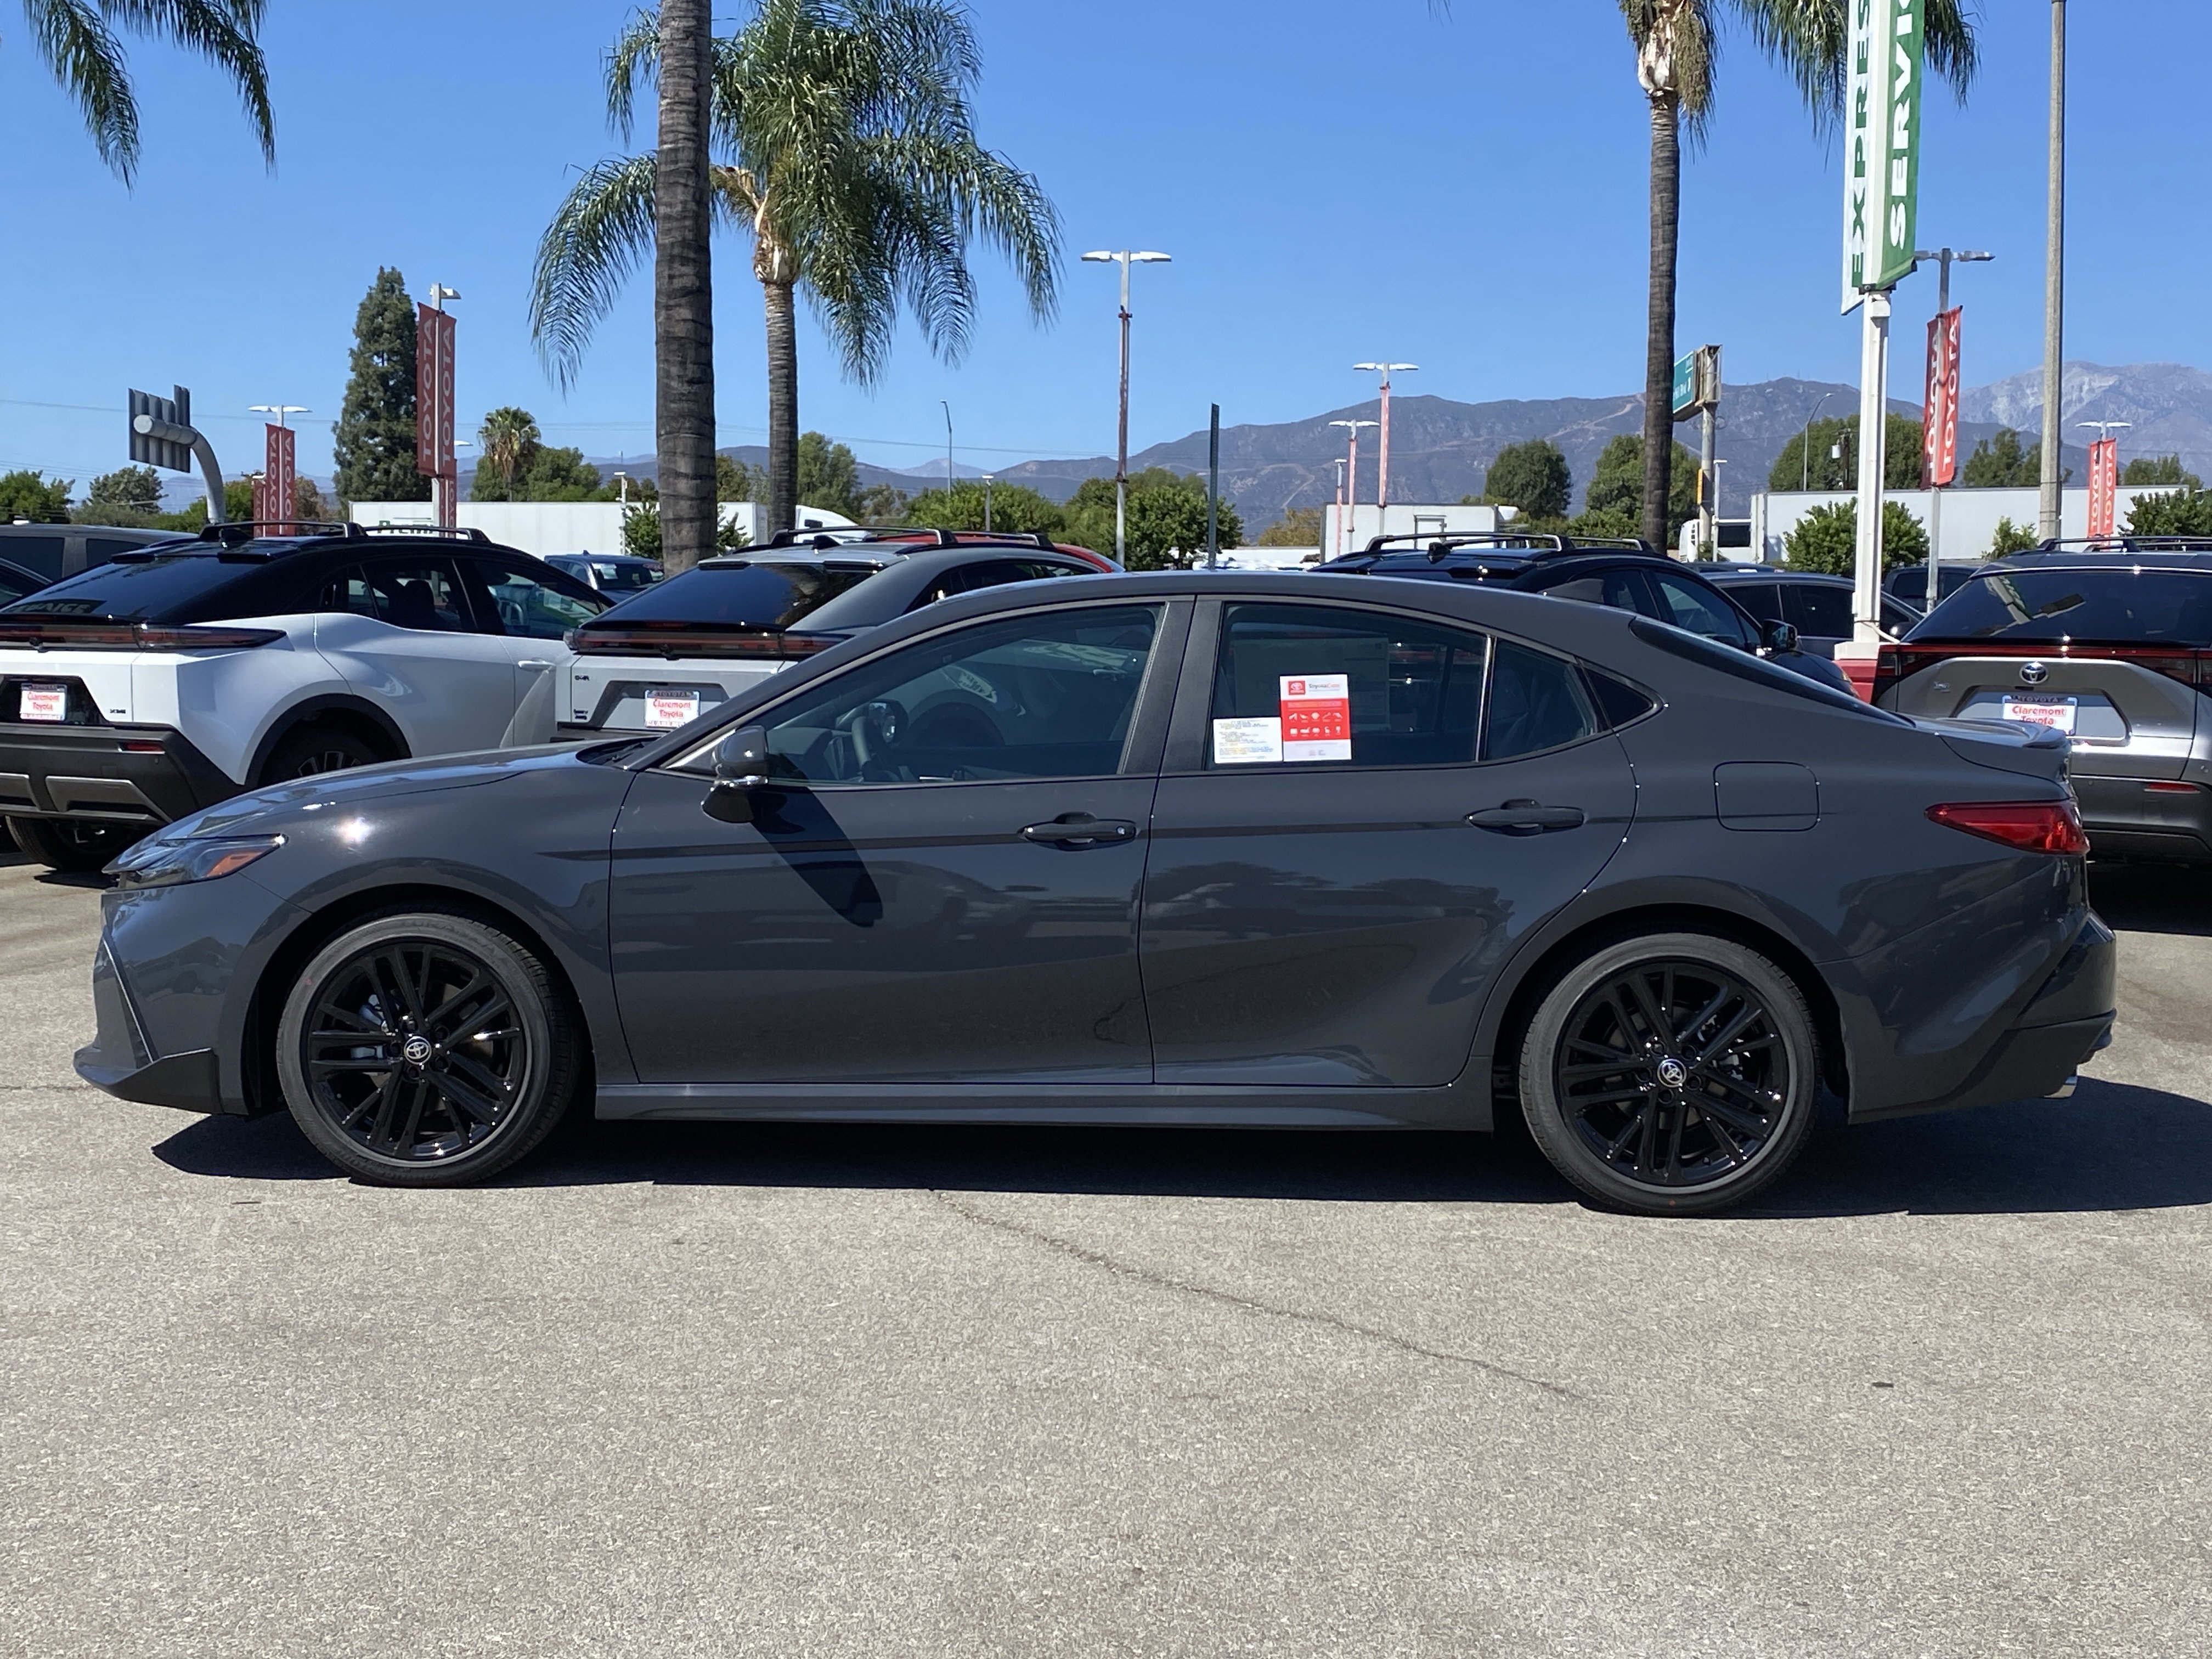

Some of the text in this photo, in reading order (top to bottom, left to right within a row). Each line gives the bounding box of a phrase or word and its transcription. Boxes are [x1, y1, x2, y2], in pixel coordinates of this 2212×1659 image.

[1889, 0, 1913, 250] SERVI
[423, 318, 432, 461] TOYOTA
[442, 326, 452, 467] TOYOTA
[1942, 317, 1958, 472] TOYOTA
[2104, 445, 2113, 528] TOYOTA
[653, 698, 691, 708] Claremont
[659, 709, 684, 718] Toyota
[2012, 706, 2066, 715] Claremont
